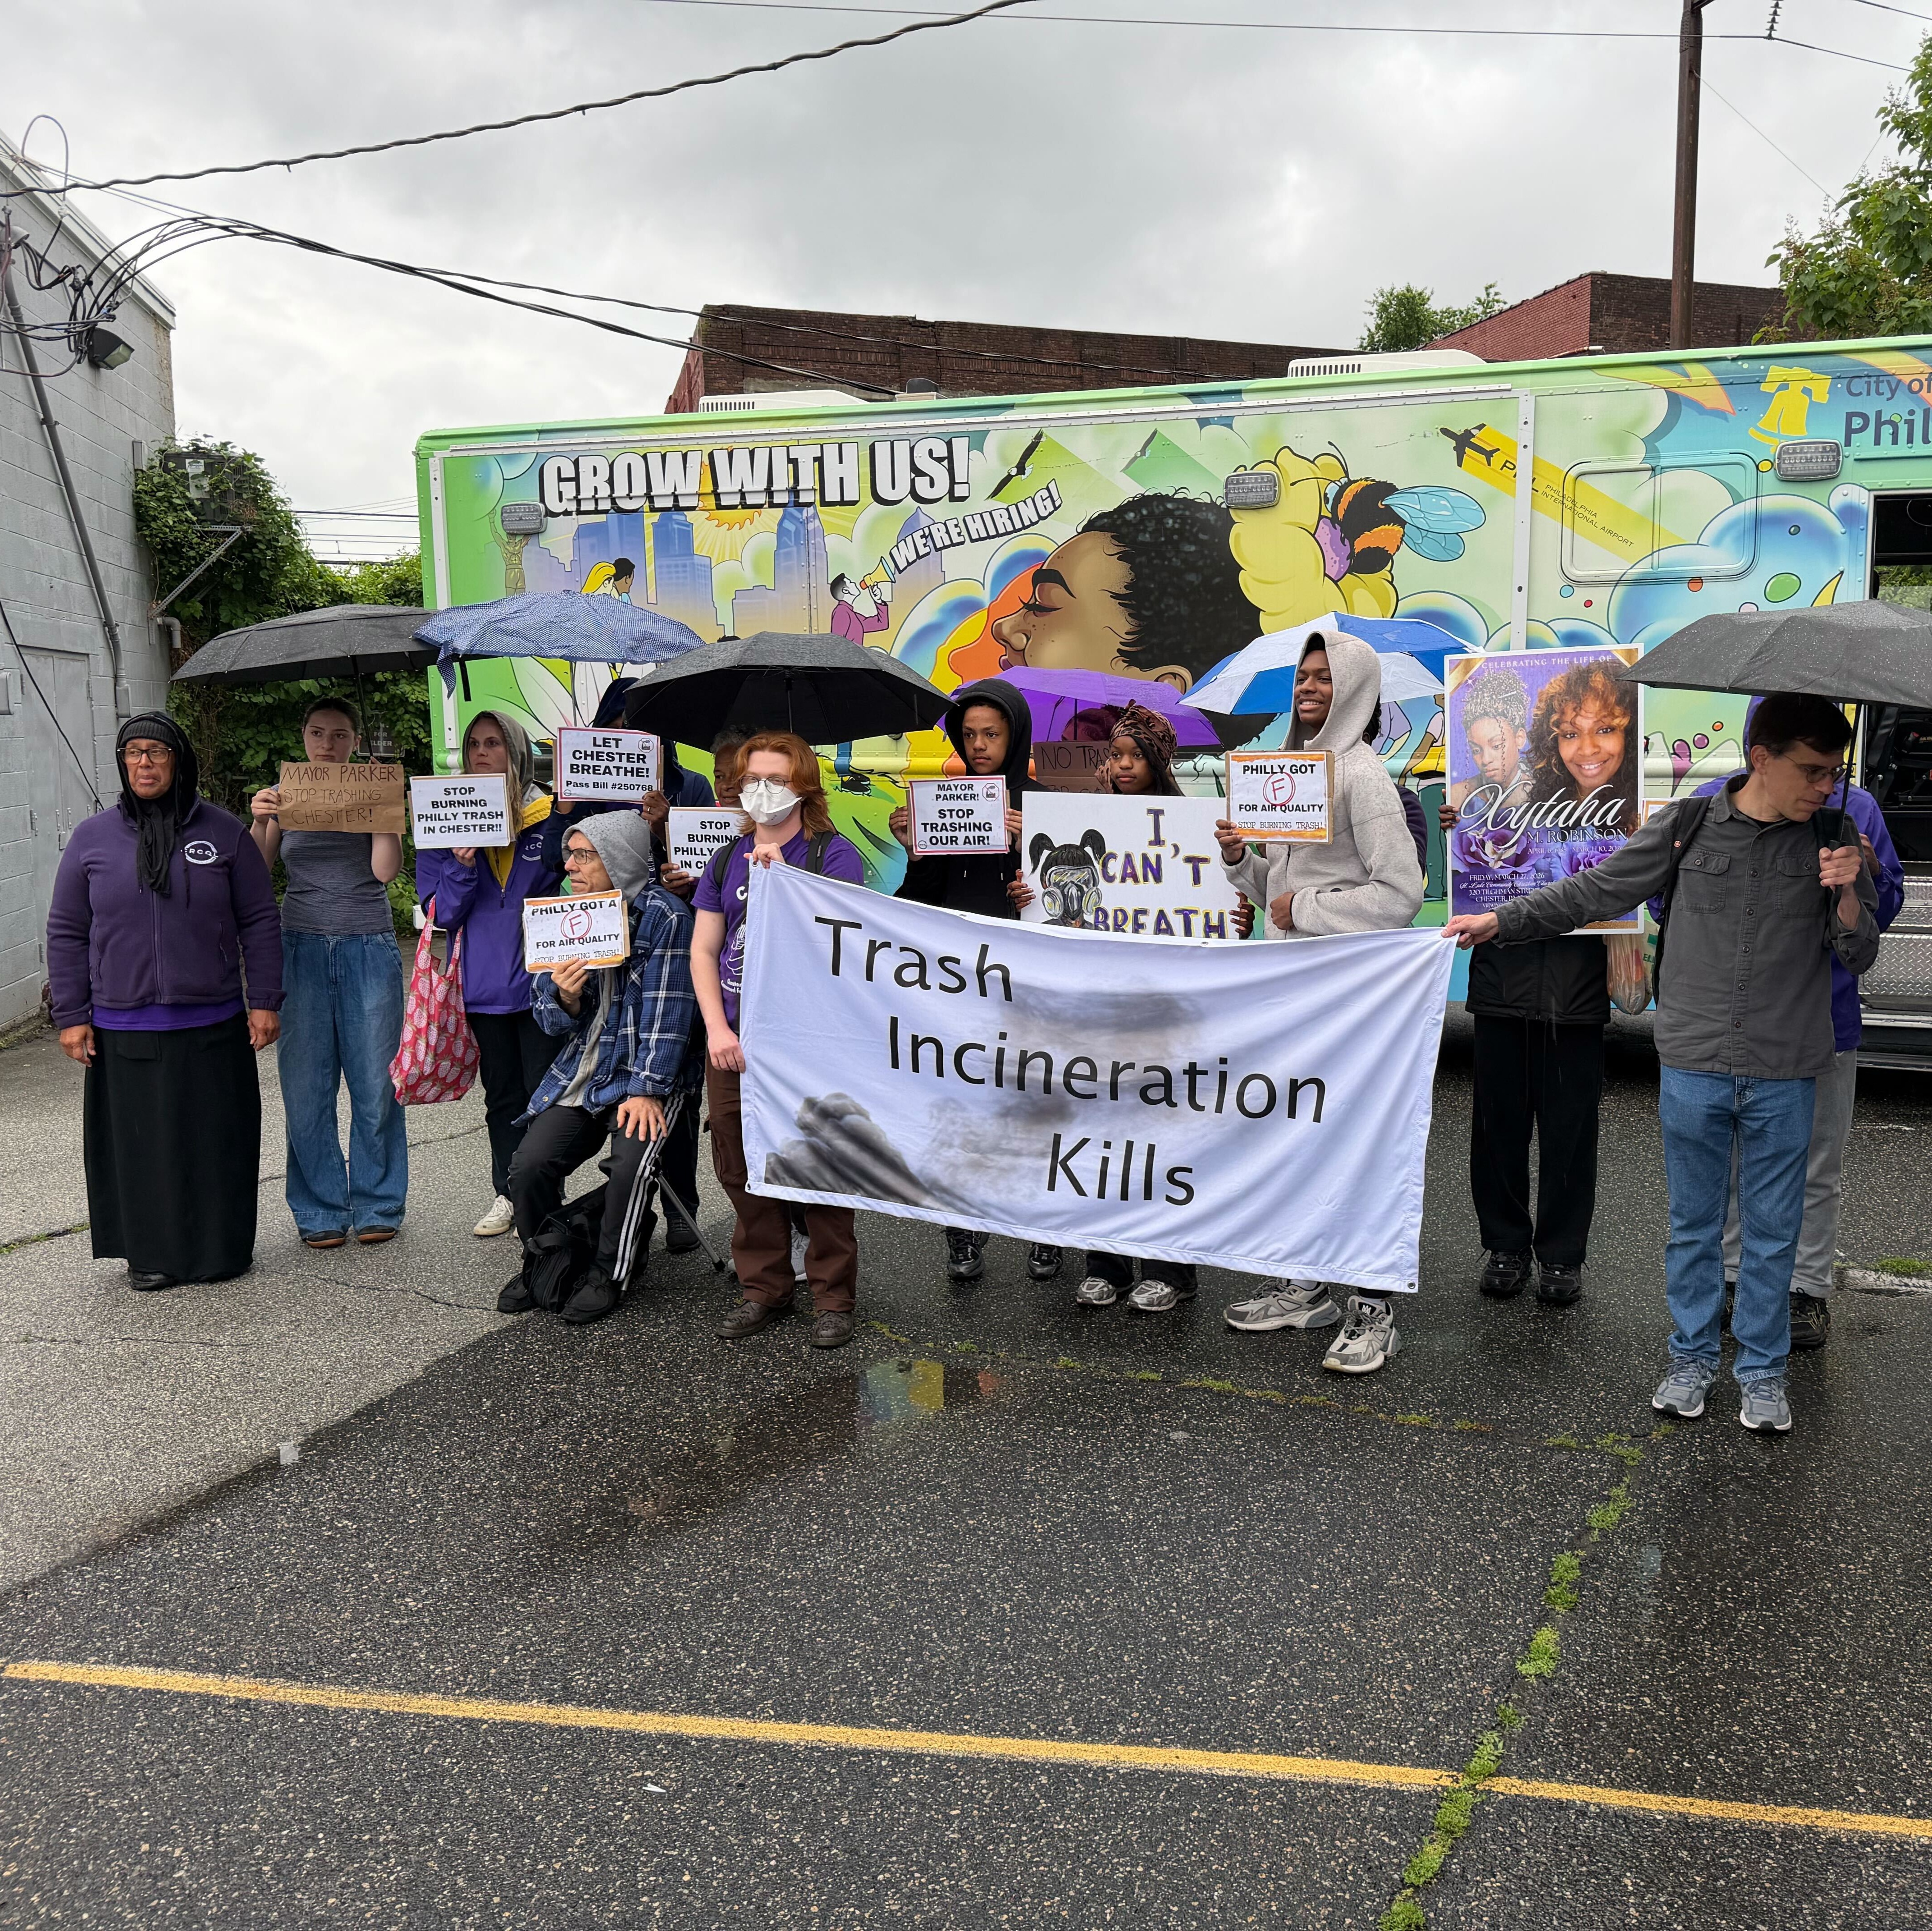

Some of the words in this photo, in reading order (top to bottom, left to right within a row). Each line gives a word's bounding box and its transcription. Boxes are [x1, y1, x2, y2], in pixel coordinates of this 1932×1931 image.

[1846, 375, 1902, 401] City
[1907, 372, 1932, 394] of
[1844, 407, 1932, 447] Phil
[539, 450, 703, 517] GROW
[709, 442, 860, 509] WITH
[870, 436, 970, 506] US!
[1500, 459, 1539, 493] PL
[1545, 484, 1598, 518] PHILADELPHIA
[889, 517, 965, 573] WE'RE
[963, 478, 1063, 543] HIRING!
[1541, 490, 1599, 528] INTERNATIONAL
[1600, 526, 1634, 547] AIRPORT
[1481, 659, 1548, 669] CELEBRATING
[1574, 656, 1594, 664] LIFE
[593, 737, 622, 748] LET
[572, 750, 647, 764] CHESTER
[1041, 746, 1071, 770] NO
[280, 766, 329, 785] MAYOR
[340, 765, 397, 783] PARKER
[570, 764, 649, 778] BREATHE!
[1243, 764, 1285, 774] PHILLY
[1290, 764, 1316, 774] GOT
[443, 787, 475, 796] STOP
[611, 783, 653, 792] #250768
[1271, 778, 1284, 801] F
[284, 789, 316, 803] STOP
[322, 789, 381, 804] TRASHING
[431, 799, 487, 809] BURNING
[938, 809, 974, 819] STOP
[1280, 804, 1324, 813] QUALITY
[291, 808, 373, 825] CHESTER!
[417, 812, 459, 822] PHILLY
[462, 811, 503, 820] TRASH
[439, 824, 502, 833] CHESTER!!
[700, 821, 730, 830] STOP
[921, 822, 992, 832] TRASHING
[1146, 807, 1167, 847] I
[929, 836, 959, 846] OUR
[963, 836, 990, 845] AIR!
[1527, 831, 1544, 844] M.
[1547, 828, 1628, 843] ROBINSON
[674, 847, 714, 856] PHILLY
[681, 860, 691, 869] IN
[1100, 842, 1211, 887] CAN'T
[531, 903, 575, 916] PHILLY
[580, 901, 605, 911] GOT
[569, 914, 582, 935] F
[536, 940, 555, 949] FOR
[558, 938, 575, 947] AIR
[578, 933, 620, 945] QUALITY
[594, 948, 620, 958] TRASH!
[815, 916, 1014, 1002] Trash
[889, 1016, 1326, 1123] Incineration
[1047, 1133, 1195, 1206] Kills
